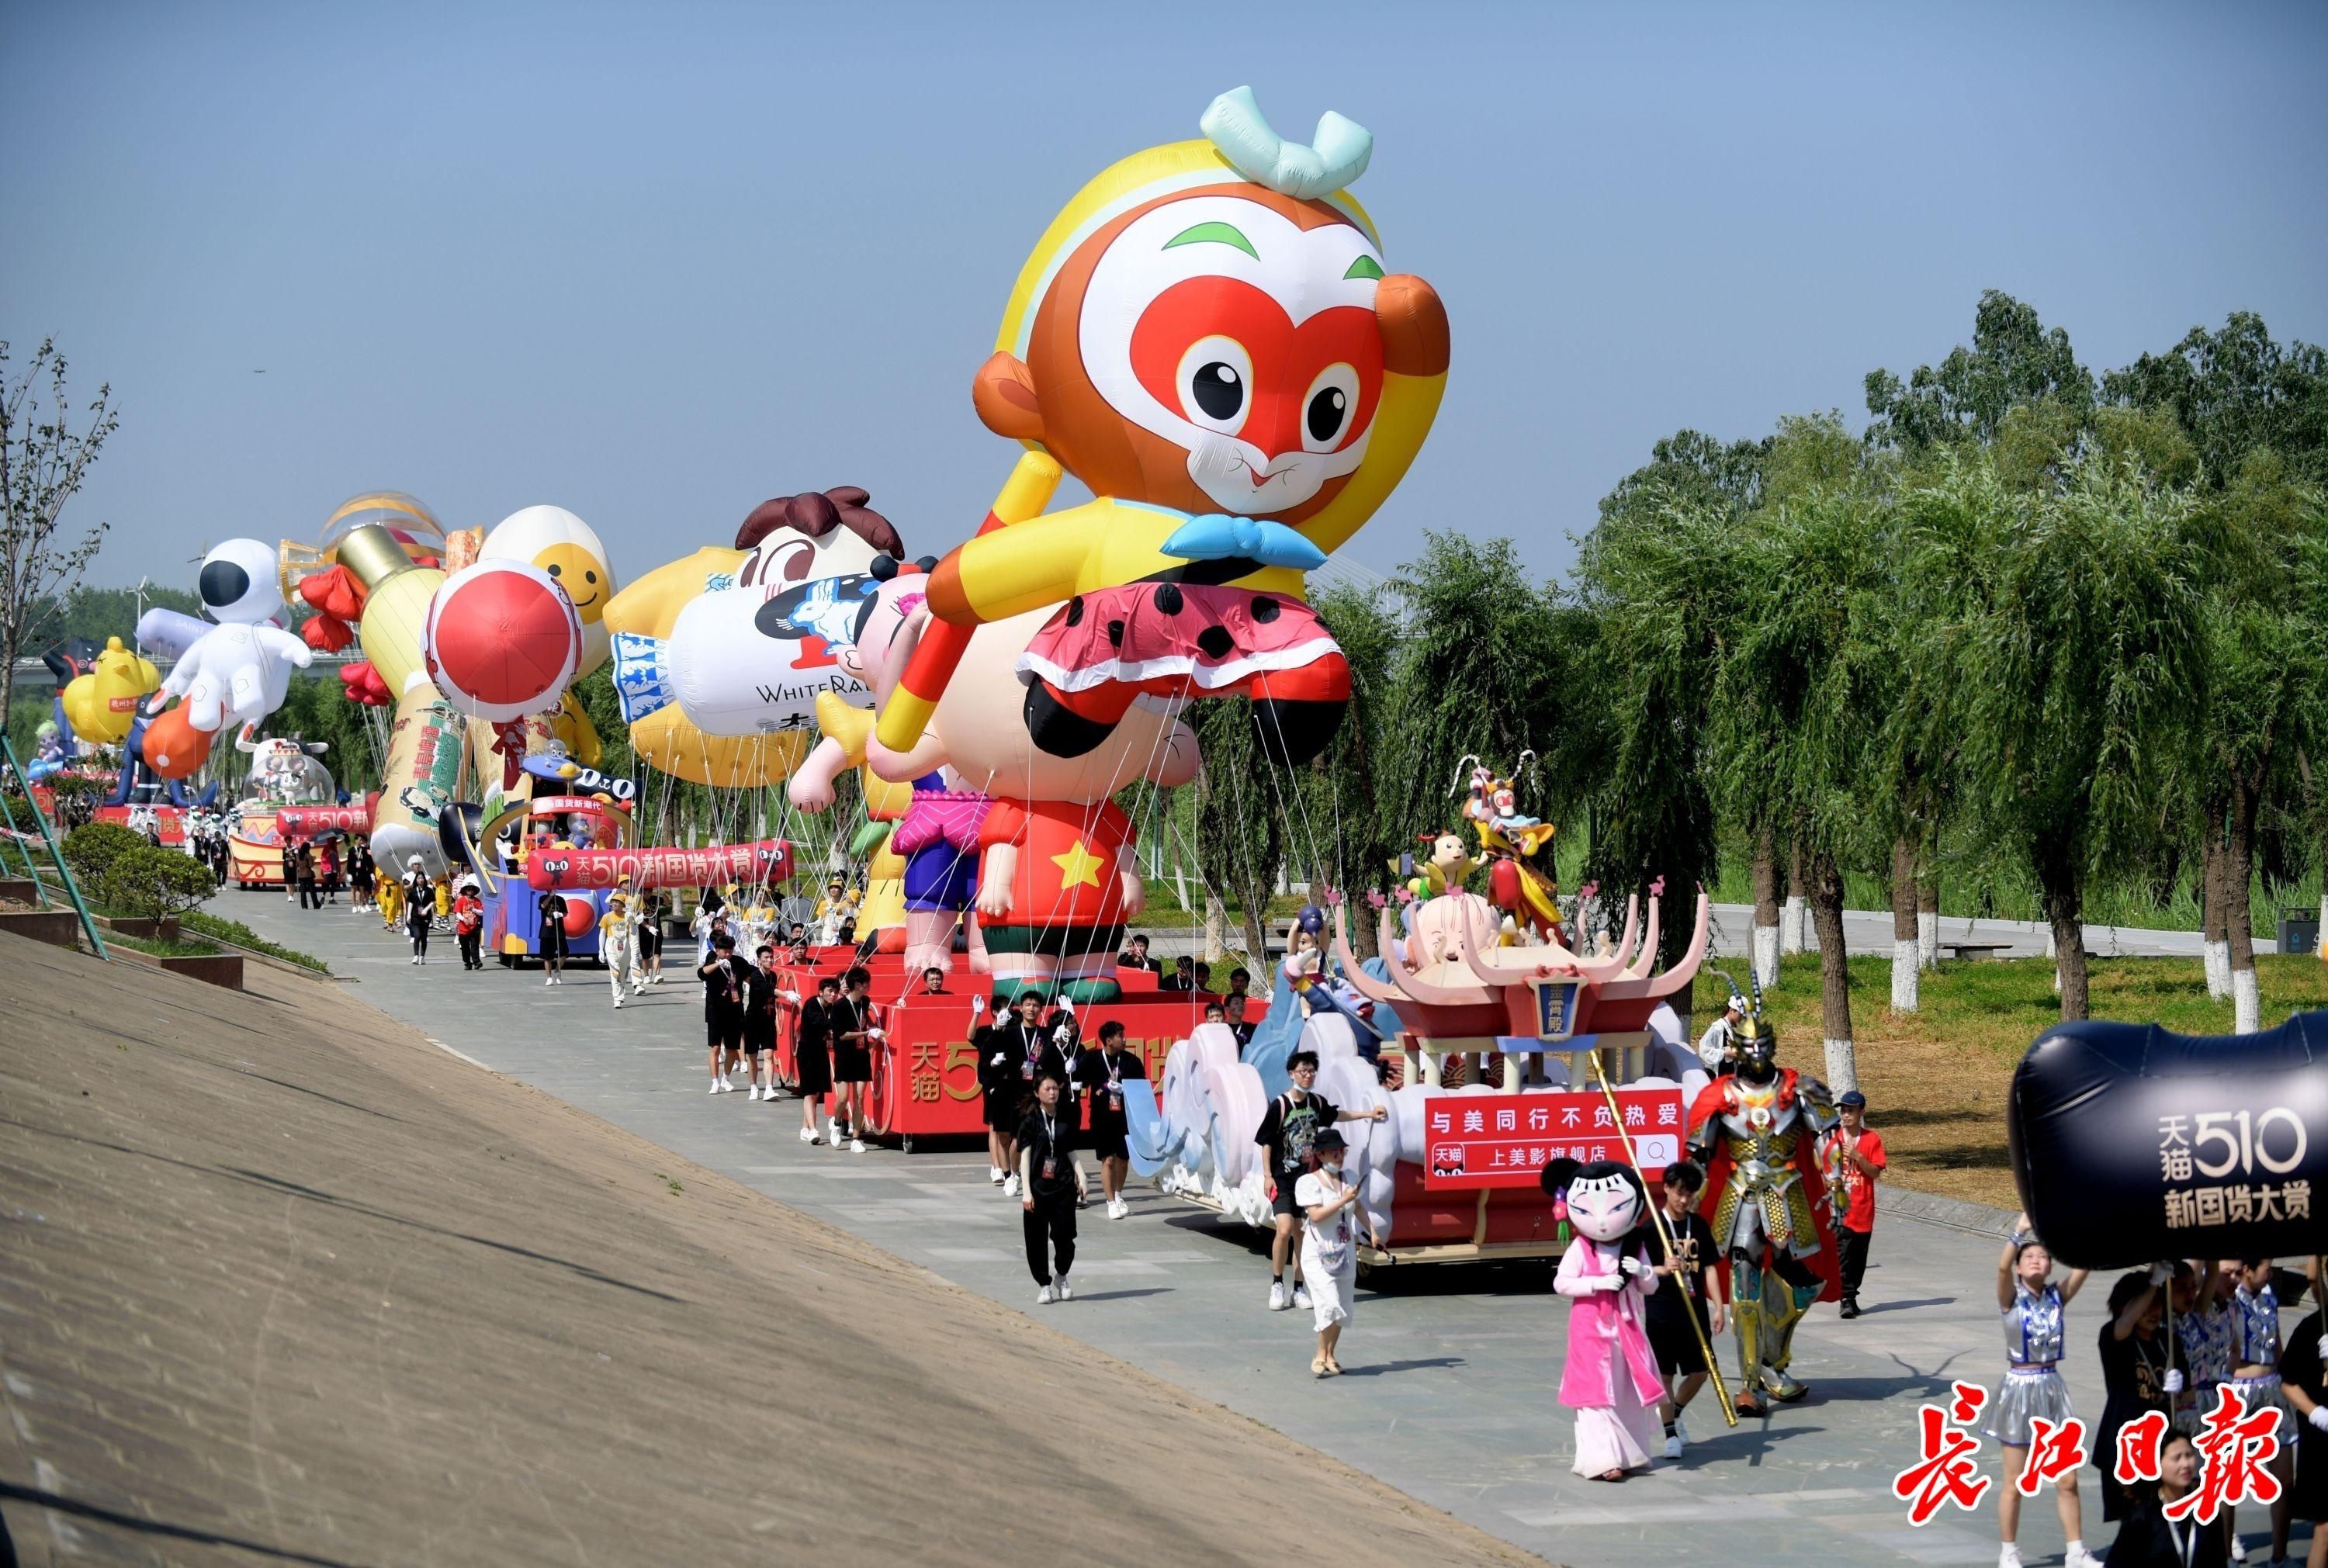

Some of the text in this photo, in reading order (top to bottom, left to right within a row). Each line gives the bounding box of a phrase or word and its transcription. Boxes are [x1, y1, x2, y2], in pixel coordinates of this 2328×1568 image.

[1431, 1102, 1678, 1134] 与美同行不负热爱
[1435, 1147, 1462, 1162] 天猫
[2163, 1179, 2312, 1229] 新国货大赏
